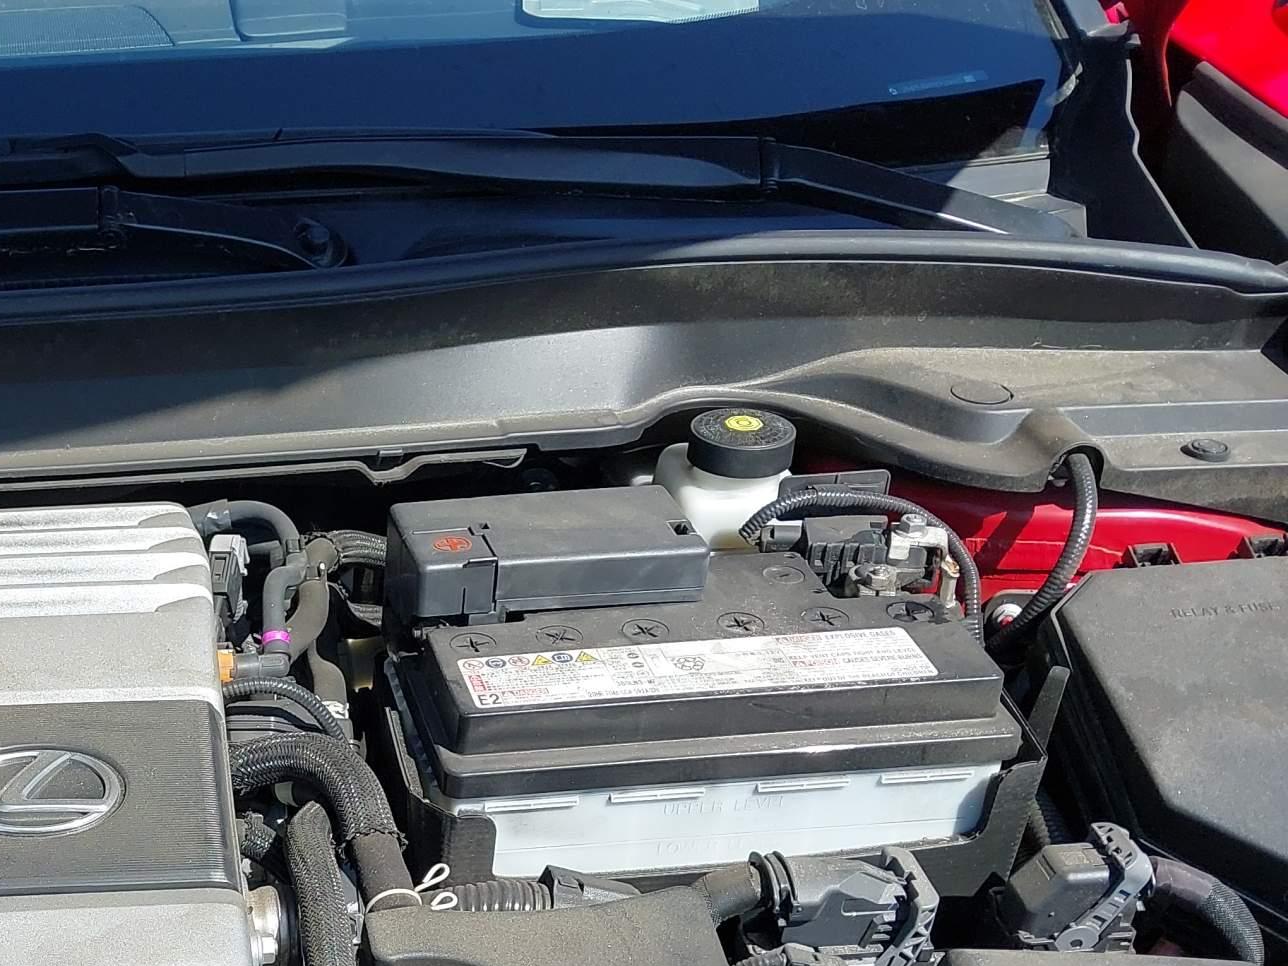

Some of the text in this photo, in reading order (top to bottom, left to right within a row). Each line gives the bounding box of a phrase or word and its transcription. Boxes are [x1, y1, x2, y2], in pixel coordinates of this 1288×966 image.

[1170, 600, 1281, 619] RELAY & FUSE
[477, 693, 502, 706] E2
